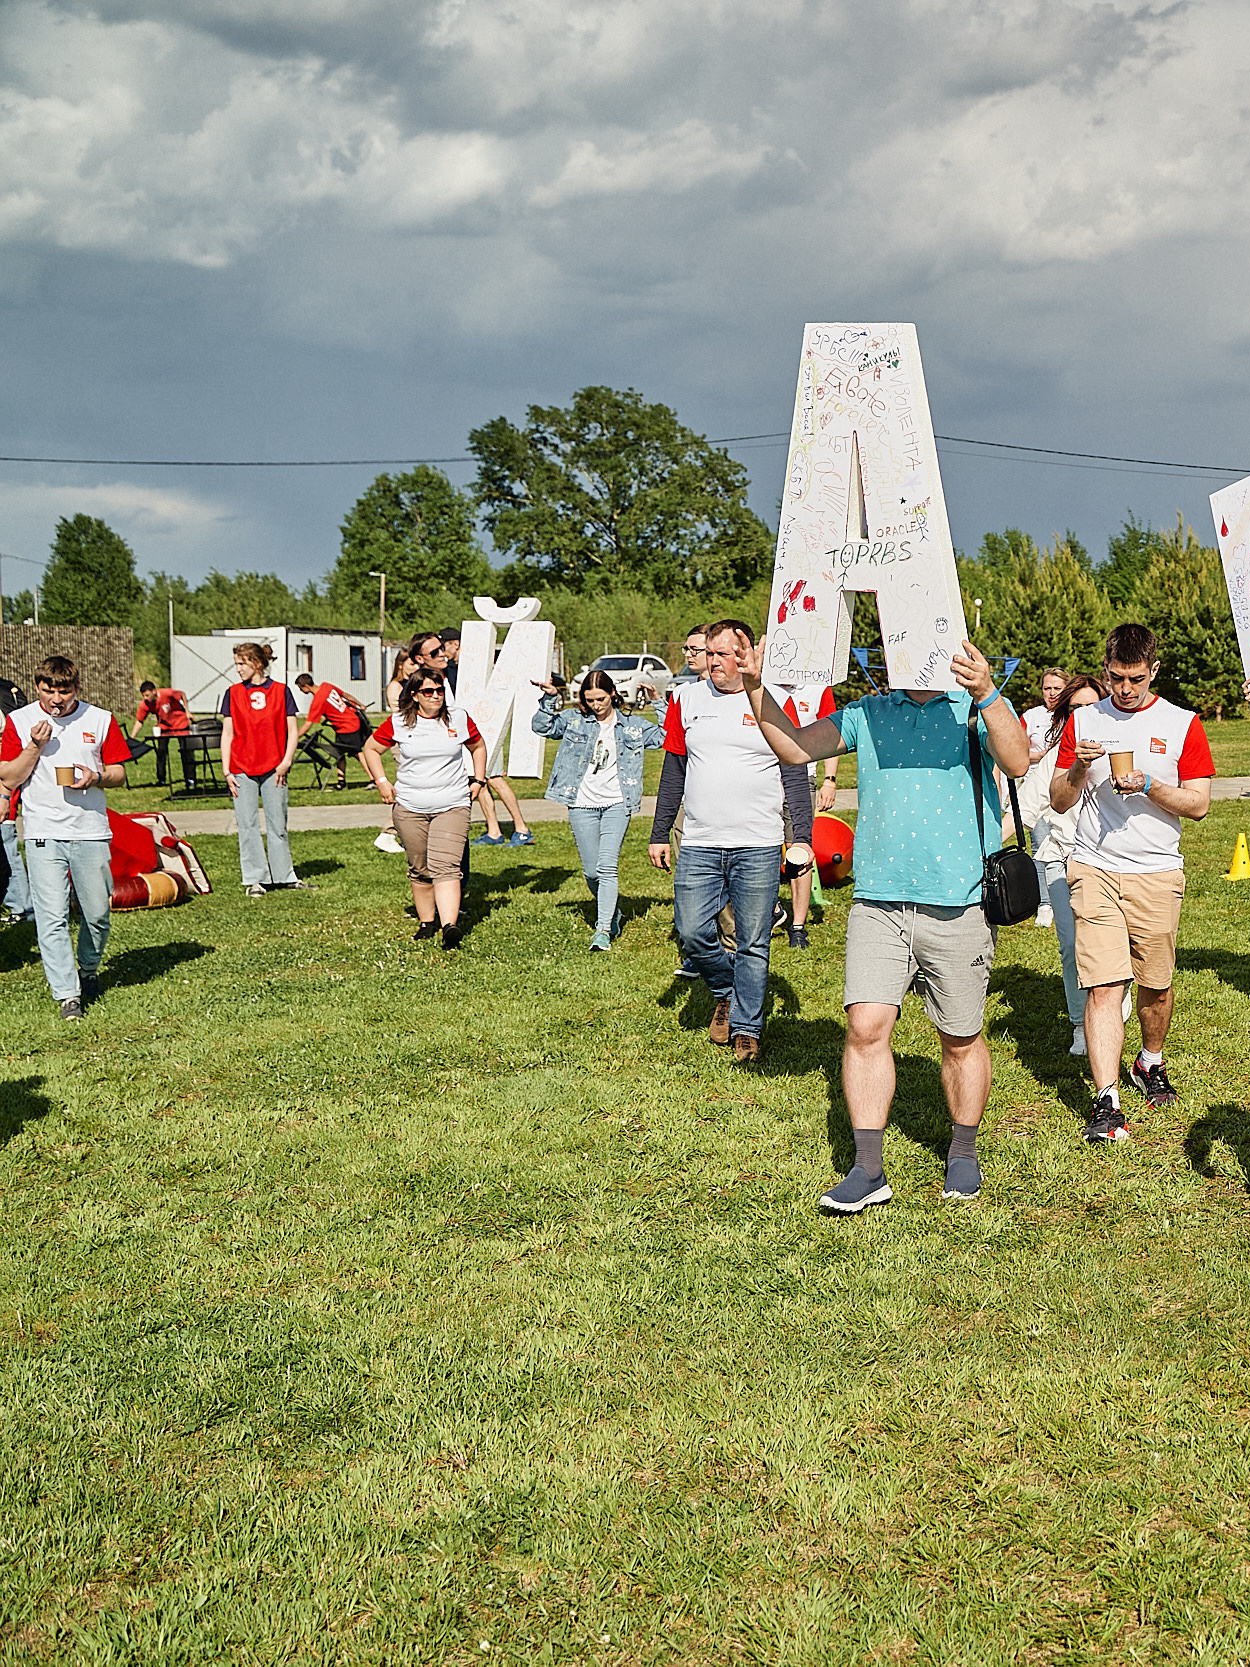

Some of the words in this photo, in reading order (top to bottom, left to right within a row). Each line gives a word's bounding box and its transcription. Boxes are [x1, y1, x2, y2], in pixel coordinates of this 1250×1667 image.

[858, 347, 901, 372] КАНИКУЛЫ
[823, 395, 890, 447] Forever
[889, 373, 924, 471] ИЗОЛЕНТА
[818, 433, 850, 454] СКБТ
[876, 520, 918, 538] ORACLE
[825, 540, 914, 569] TOPRBS
[888, 631, 908, 645] FAF
[249, 691, 267, 710] 3
